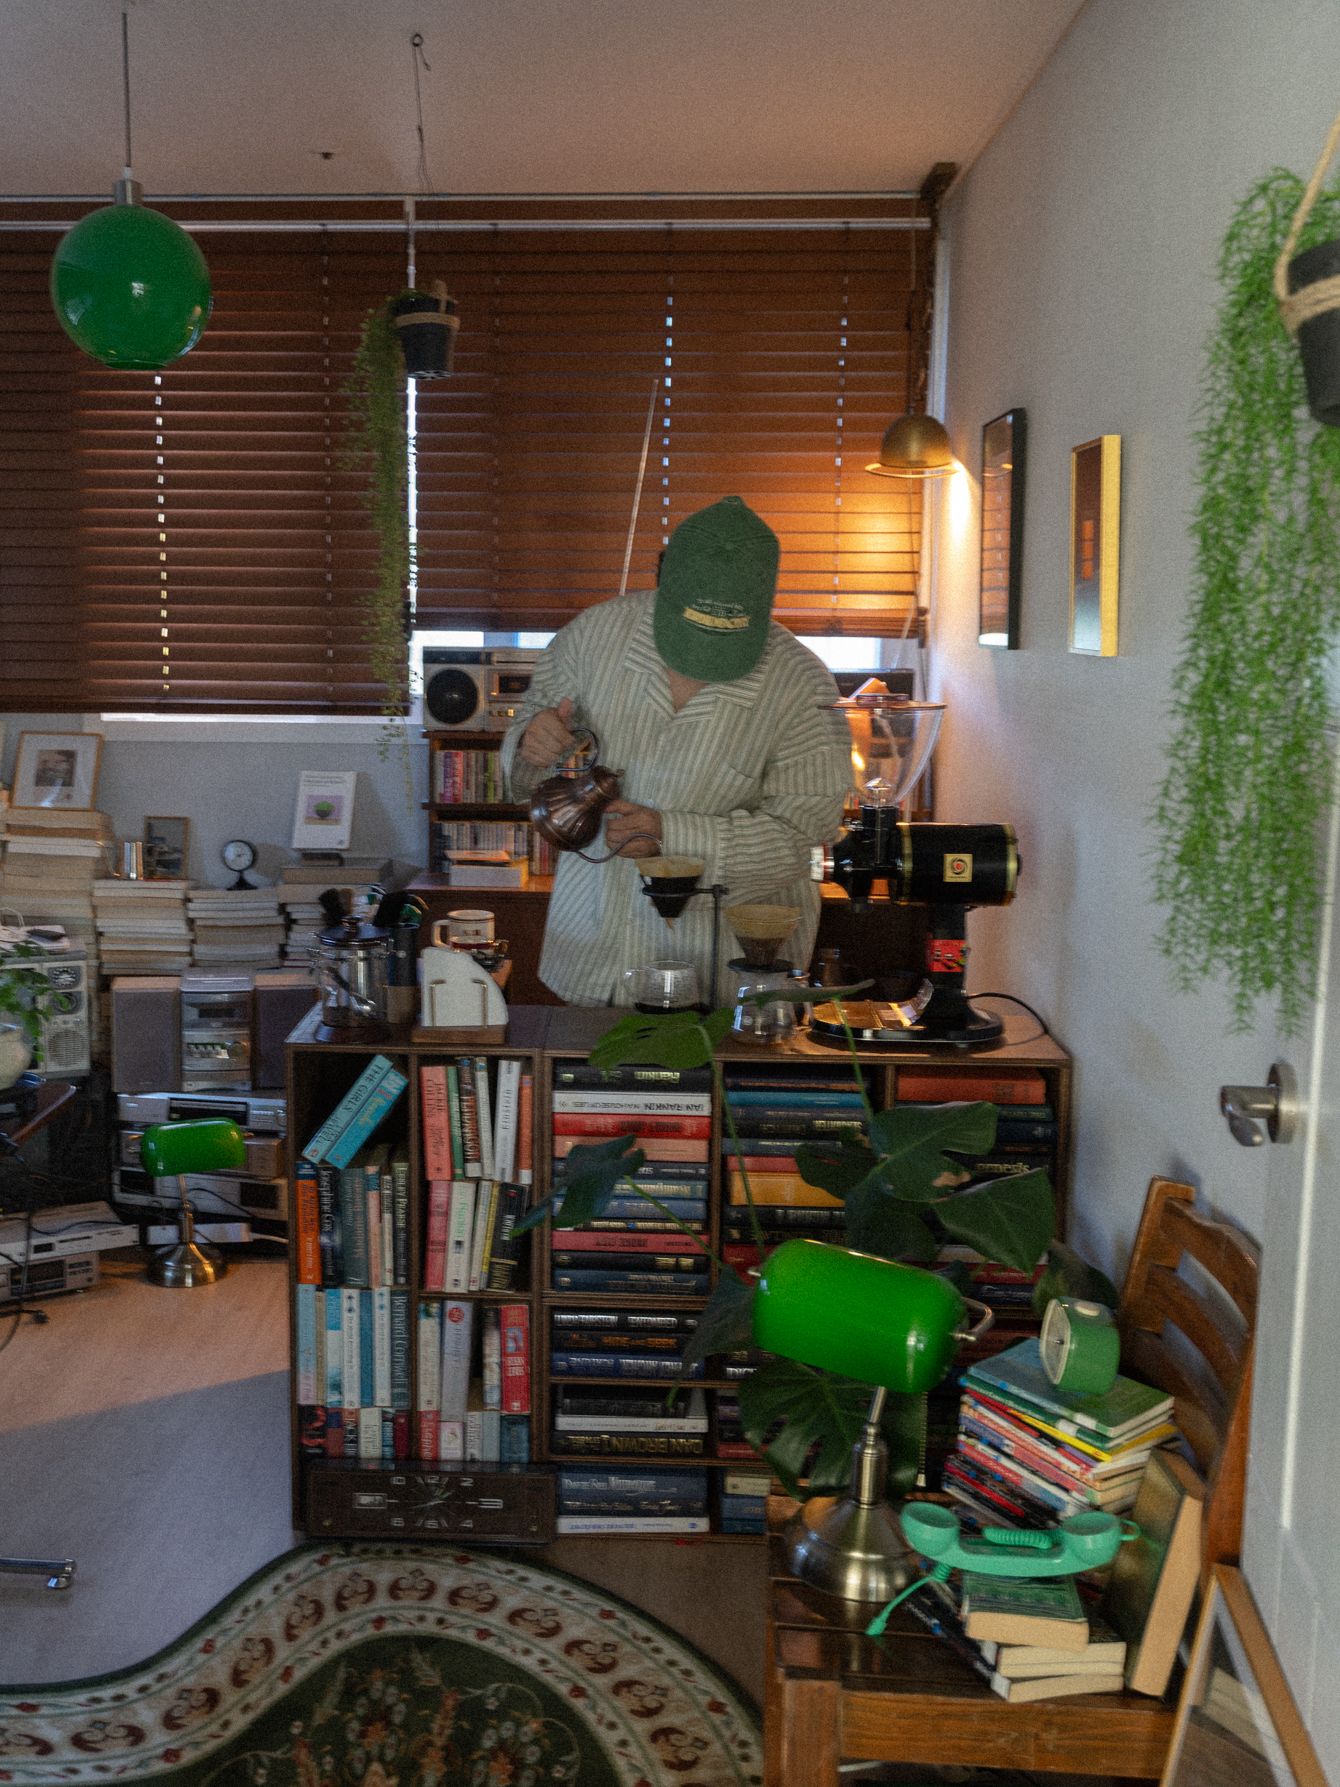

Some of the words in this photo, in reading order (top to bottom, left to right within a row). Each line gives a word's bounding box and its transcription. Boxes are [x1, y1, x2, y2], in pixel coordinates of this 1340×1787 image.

[365, 1064, 384, 1083] THE
[342, 1084, 368, 1113] GIRLS
[460, 1095, 481, 1160] PENDRAGON
[318, 1169, 335, 1213] Josephine
[320, 1213, 335, 1232] Cox
[391, 1296, 409, 1338] Bernard
[391, 1340, 409, 1384] Cornwell
[612, 1436, 669, 1453] BROWN
[460, 1477, 475, 1487] 2
